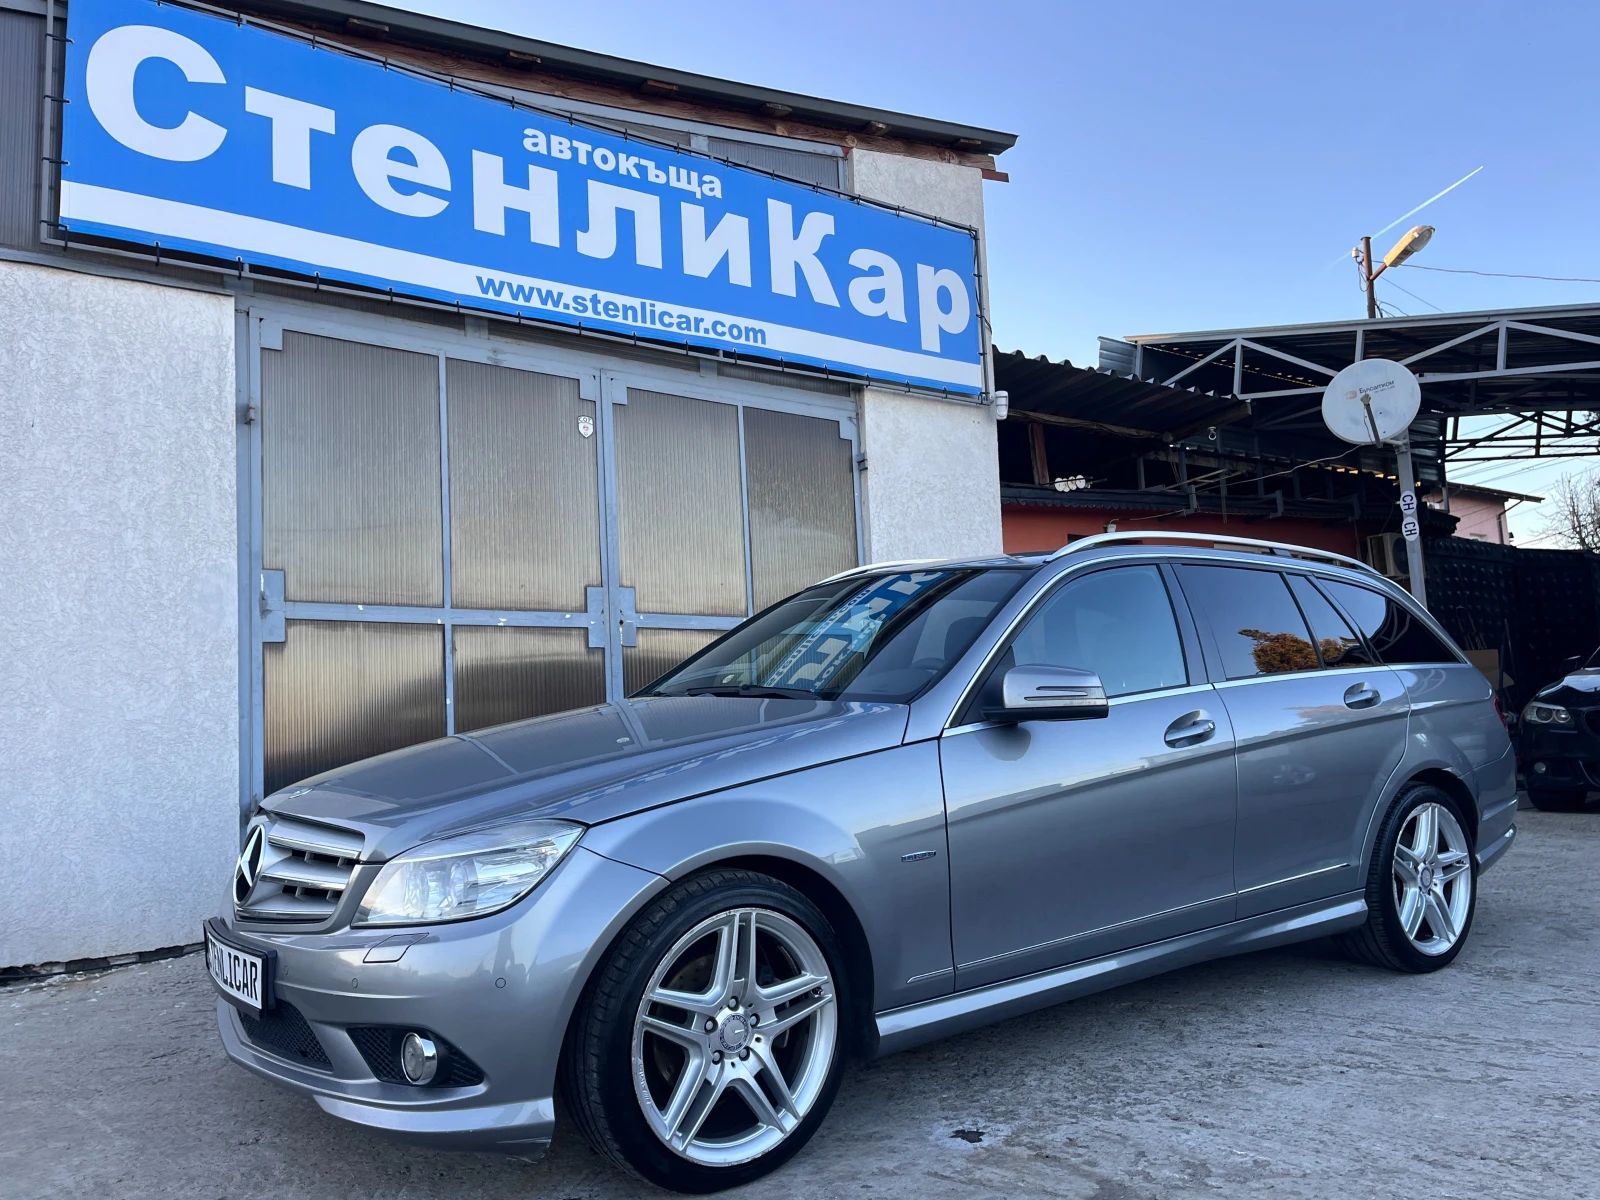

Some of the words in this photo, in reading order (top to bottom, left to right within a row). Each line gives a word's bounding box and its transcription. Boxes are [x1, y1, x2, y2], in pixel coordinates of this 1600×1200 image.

[86, 25, 971, 354] СтенлиКар
[522, 128, 722, 199] автокъща
[475, 275, 767, 345] www.stenlicar.com
[1402, 494, 1415, 511] CH
[1404, 521, 1417, 537] CH
